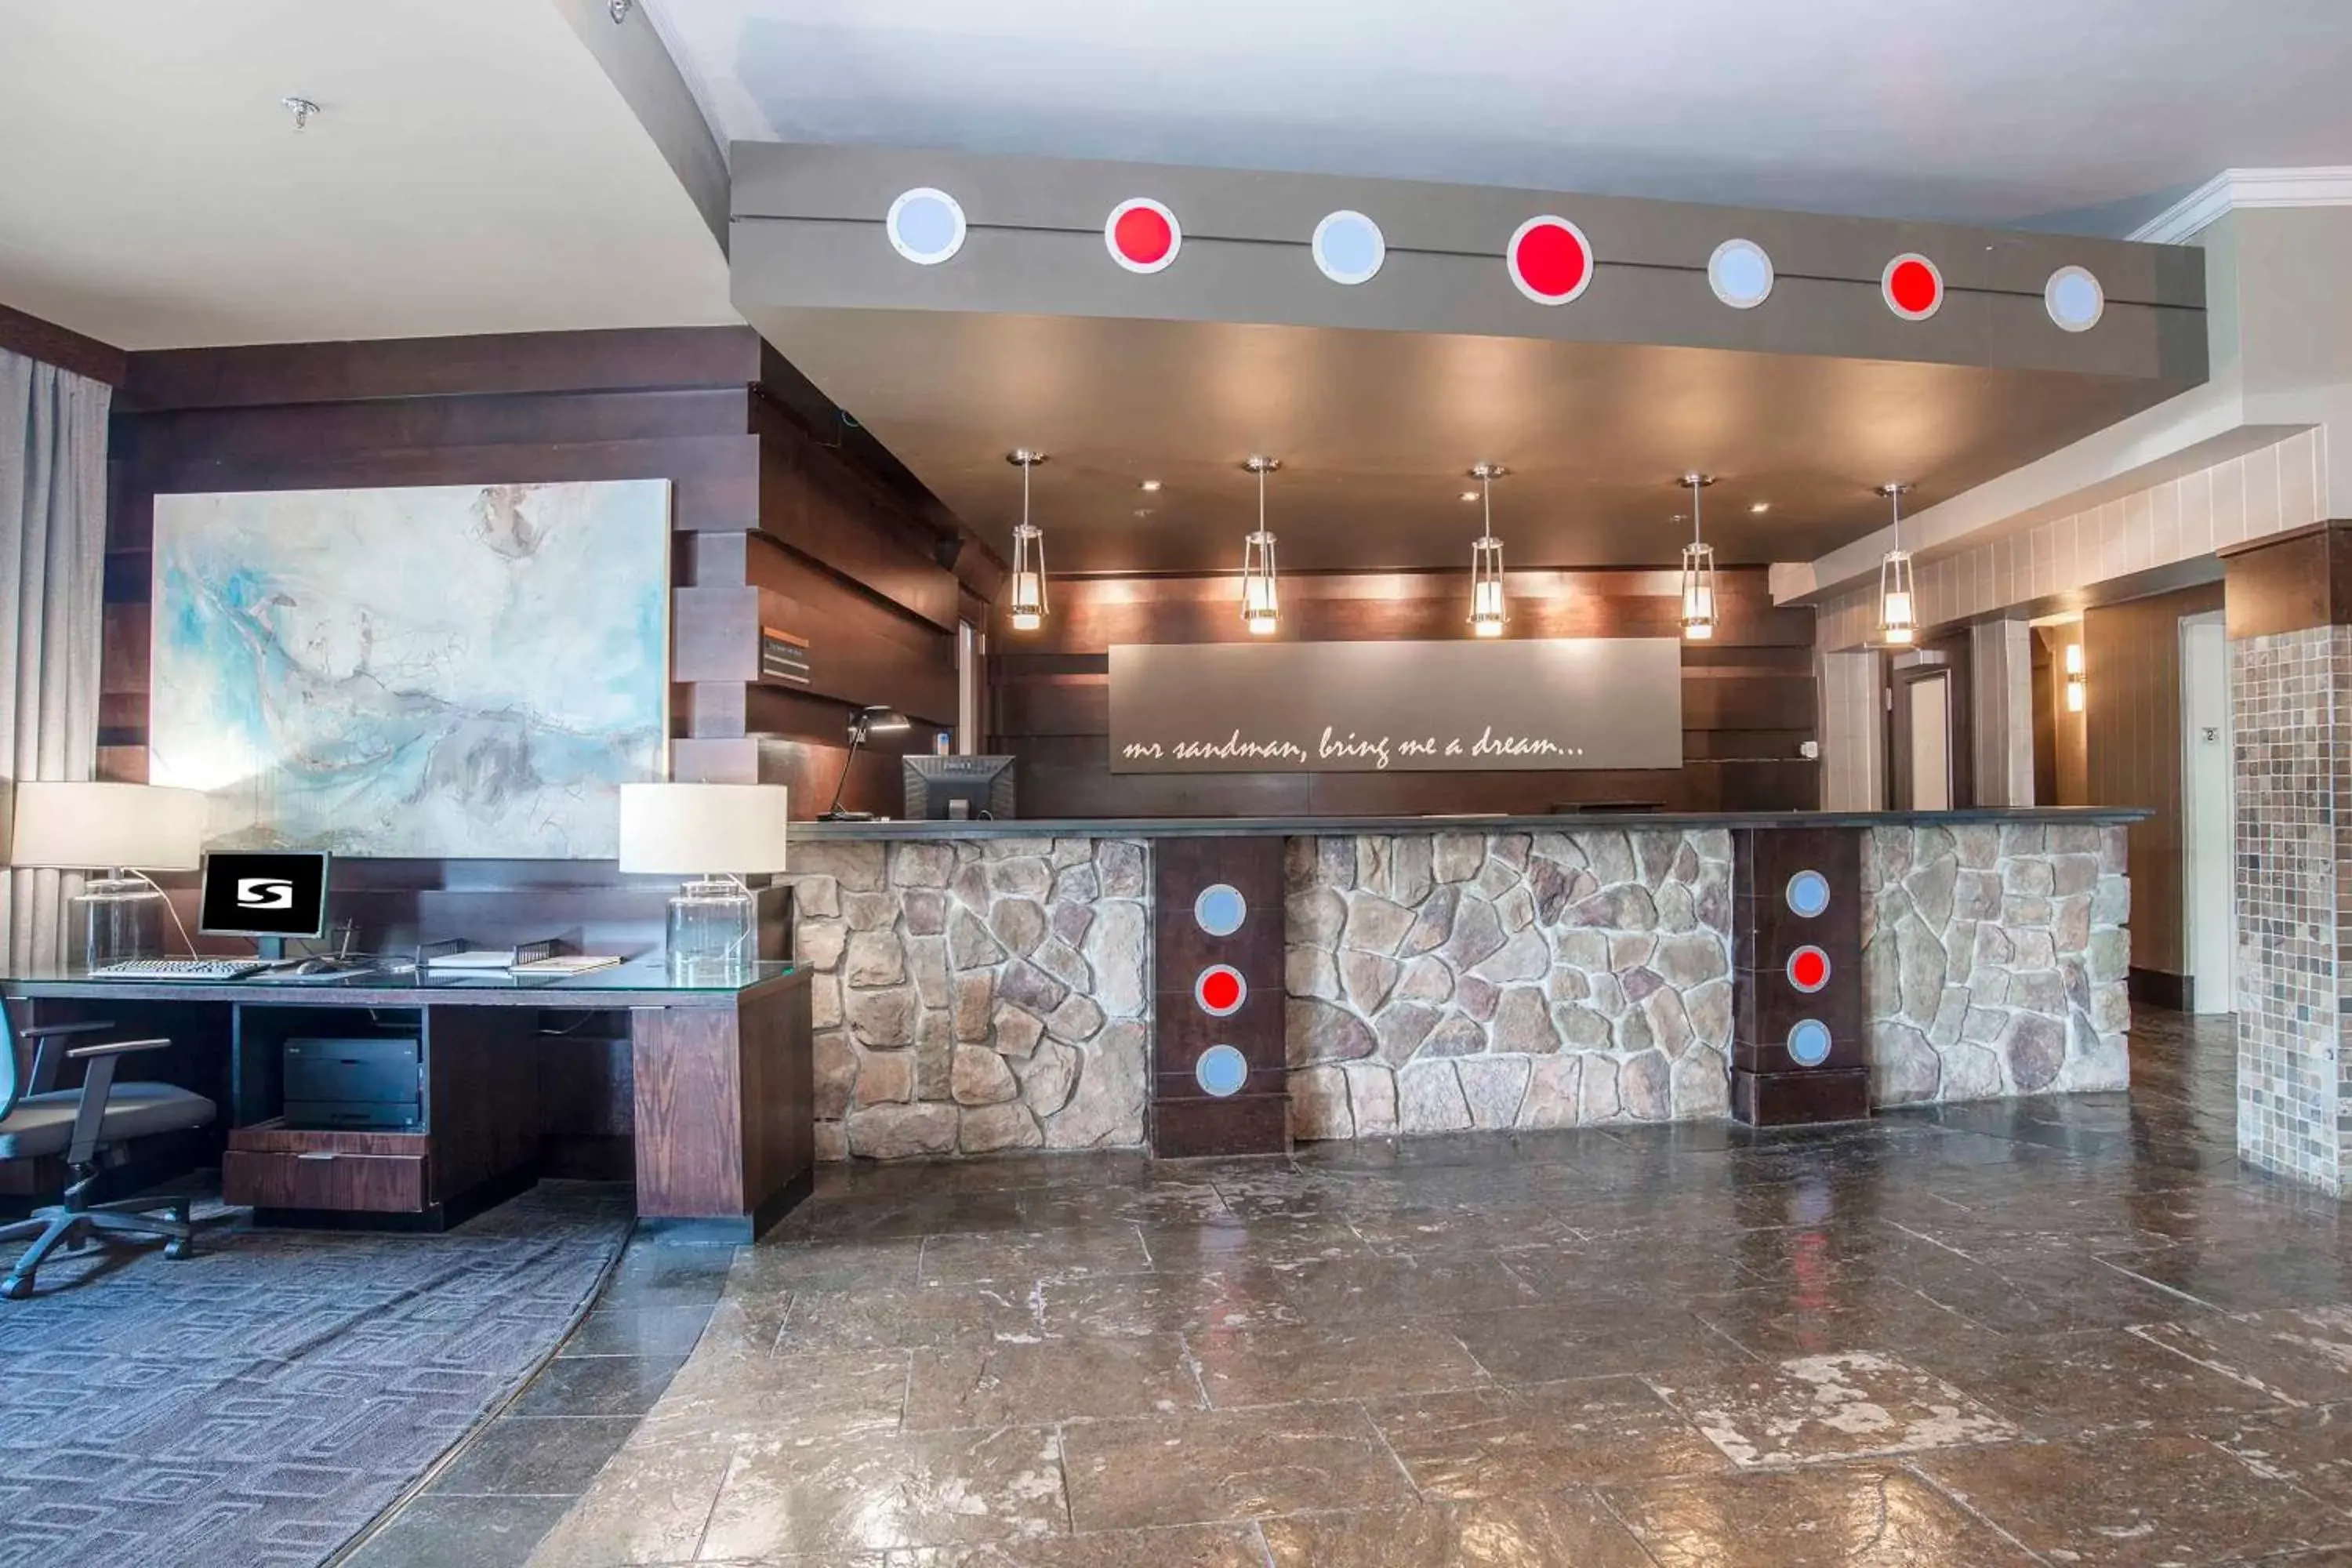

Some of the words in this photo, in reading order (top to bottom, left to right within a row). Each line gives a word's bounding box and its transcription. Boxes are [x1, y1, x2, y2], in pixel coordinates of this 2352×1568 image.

[1123, 741, 1163, 759] mr
[1173, 728, 1307, 763] sandman,
[1319, 725, 1389, 769] bring
[1399, 737, 1436, 756] me
[1445, 738, 1463, 756] a
[1472, 725, 1583, 756] dream...
